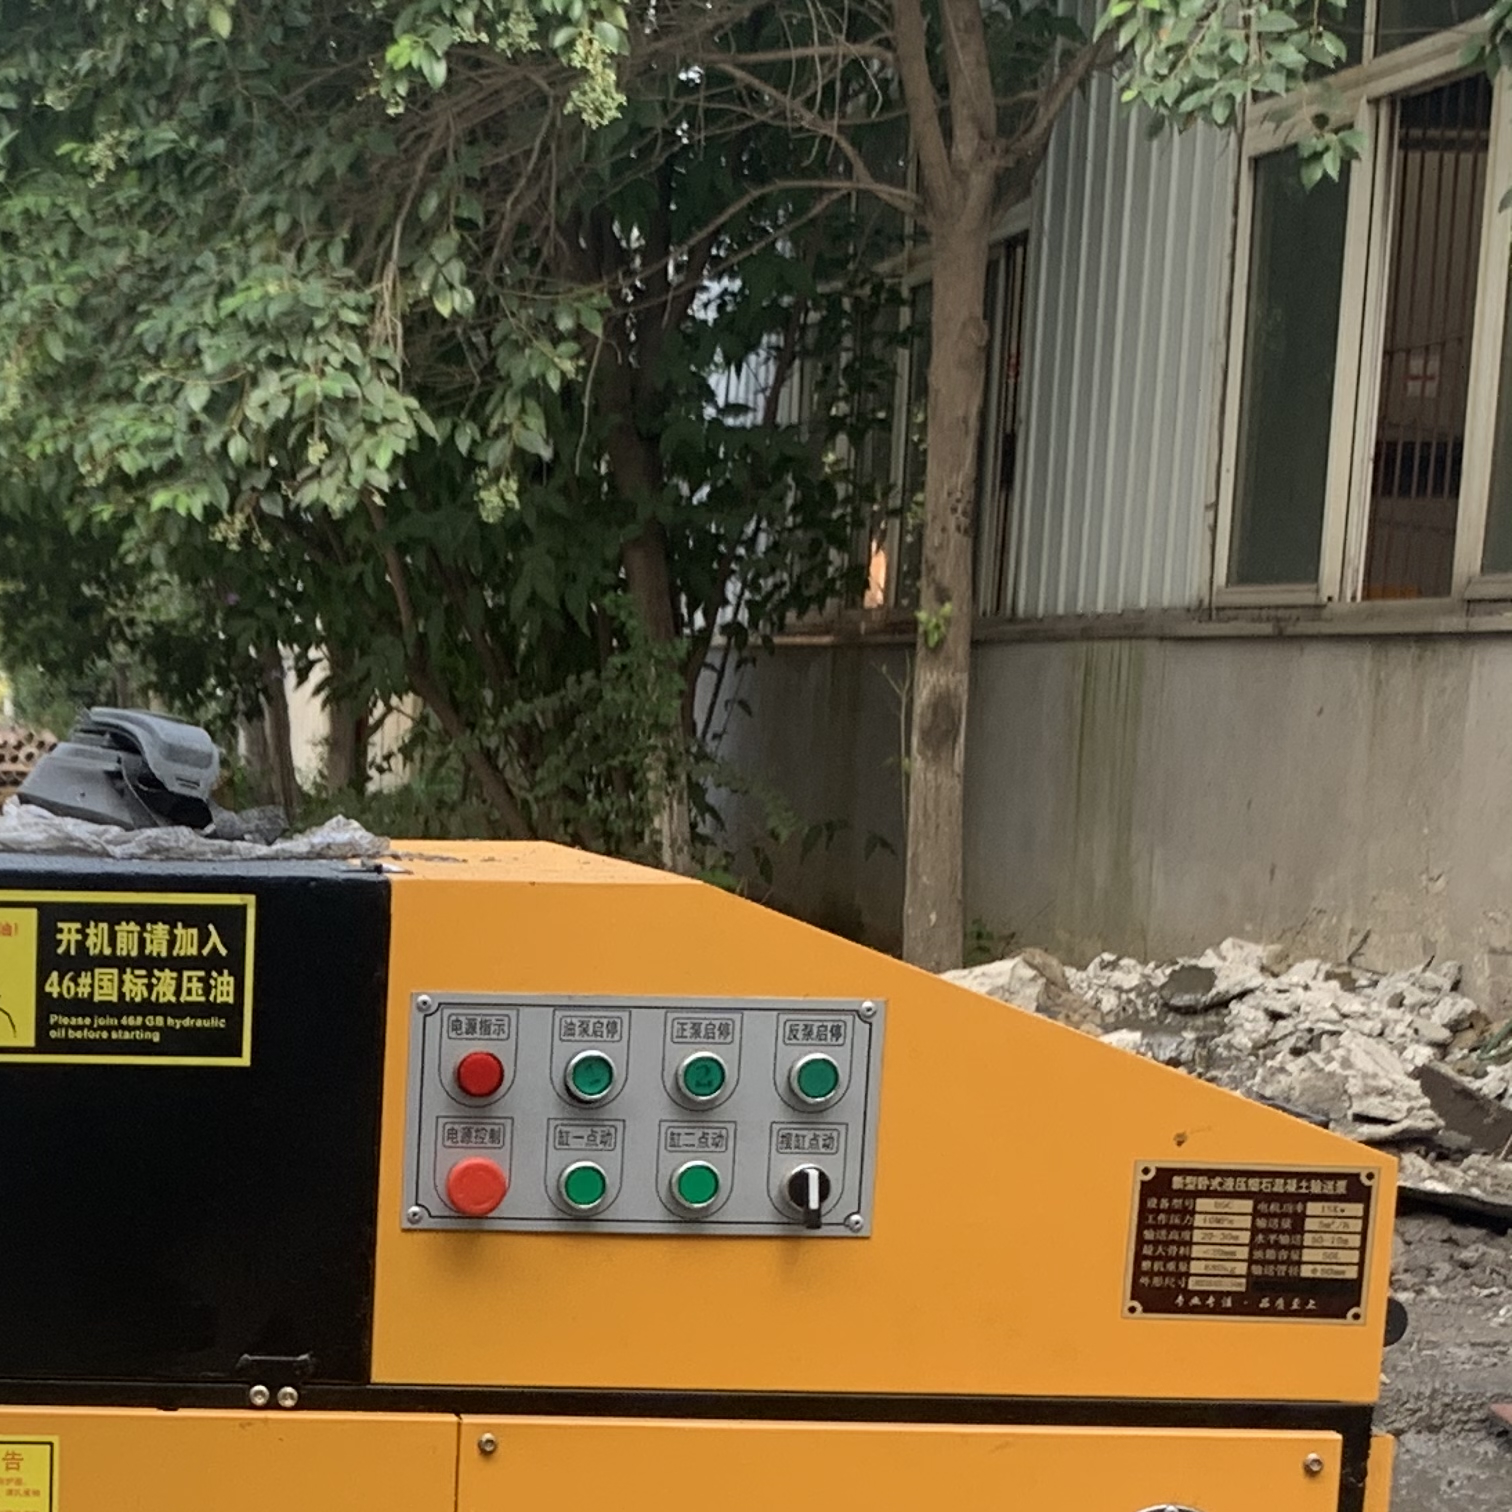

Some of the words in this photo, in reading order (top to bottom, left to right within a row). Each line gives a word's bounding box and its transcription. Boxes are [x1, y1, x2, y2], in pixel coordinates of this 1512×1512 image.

[55, 920, 228, 957] 开机前请加入
[44, 967, 235, 1004] 46#国标液压油
[49, 1013, 91, 1026] Please
[93, 1014, 119, 1028] join
[167, 1016, 226, 1029] hydraulic
[450, 1017, 507, 1036] 电源指示
[562, 1019, 619, 1038] 油泵启停
[675, 1021, 732, 1040] 正泵启停
[49, 1028, 65, 1039] oil
[67, 1028, 109, 1040] before
[110, 1029, 161, 1043] starting
[787, 1023, 844, 1042] 反泵启停
[446, 1126, 502, 1145] 电源控制
[557, 1128, 614, 1147] 缸一点动
[669, 1130, 725, 1149] 缸二点动
